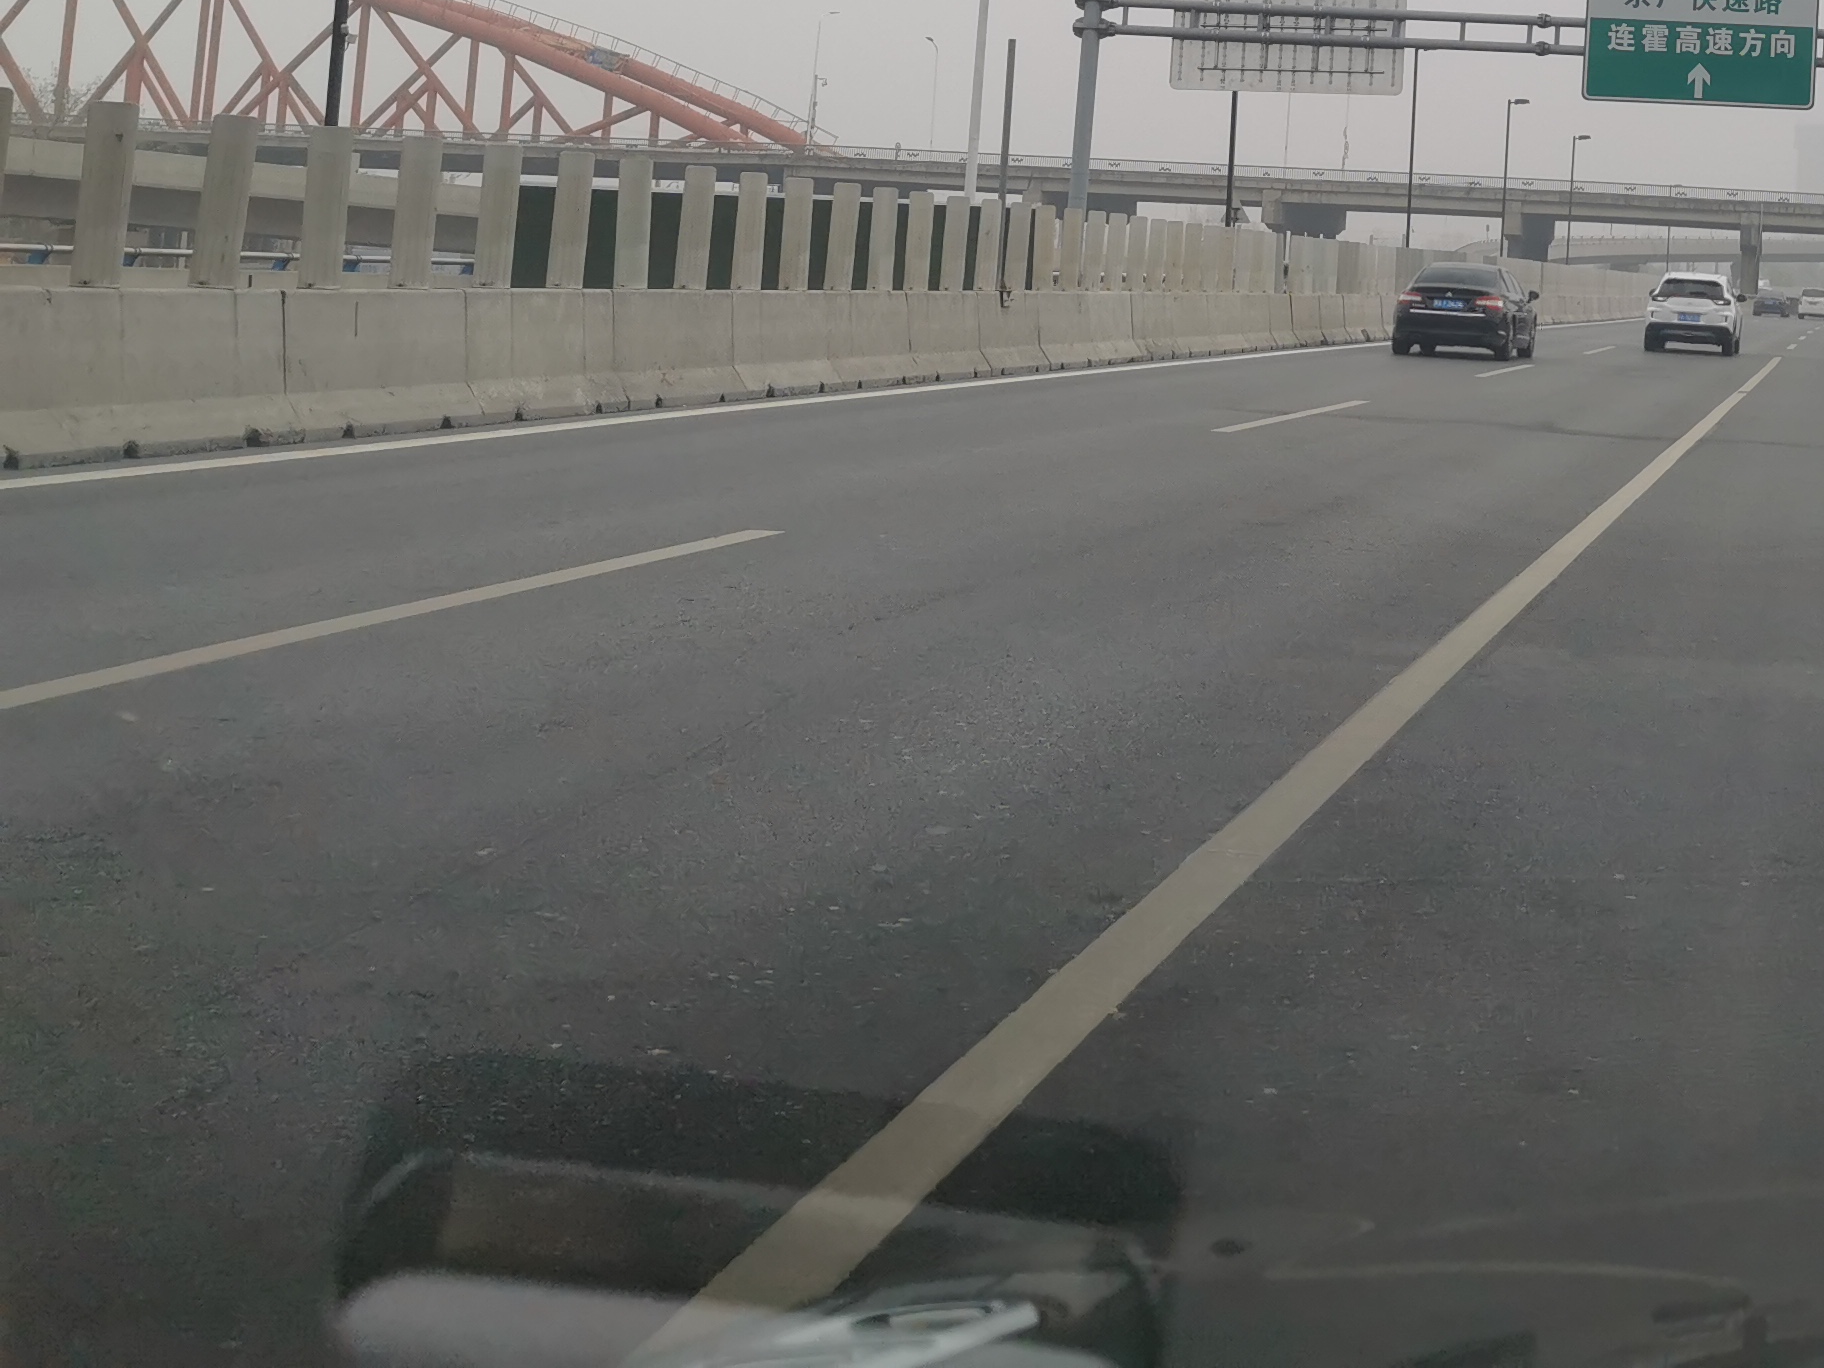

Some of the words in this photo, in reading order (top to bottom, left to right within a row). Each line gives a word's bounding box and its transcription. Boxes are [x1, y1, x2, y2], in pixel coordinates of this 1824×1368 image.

[1607, 22, 1796, 59] 连霍高速方向
